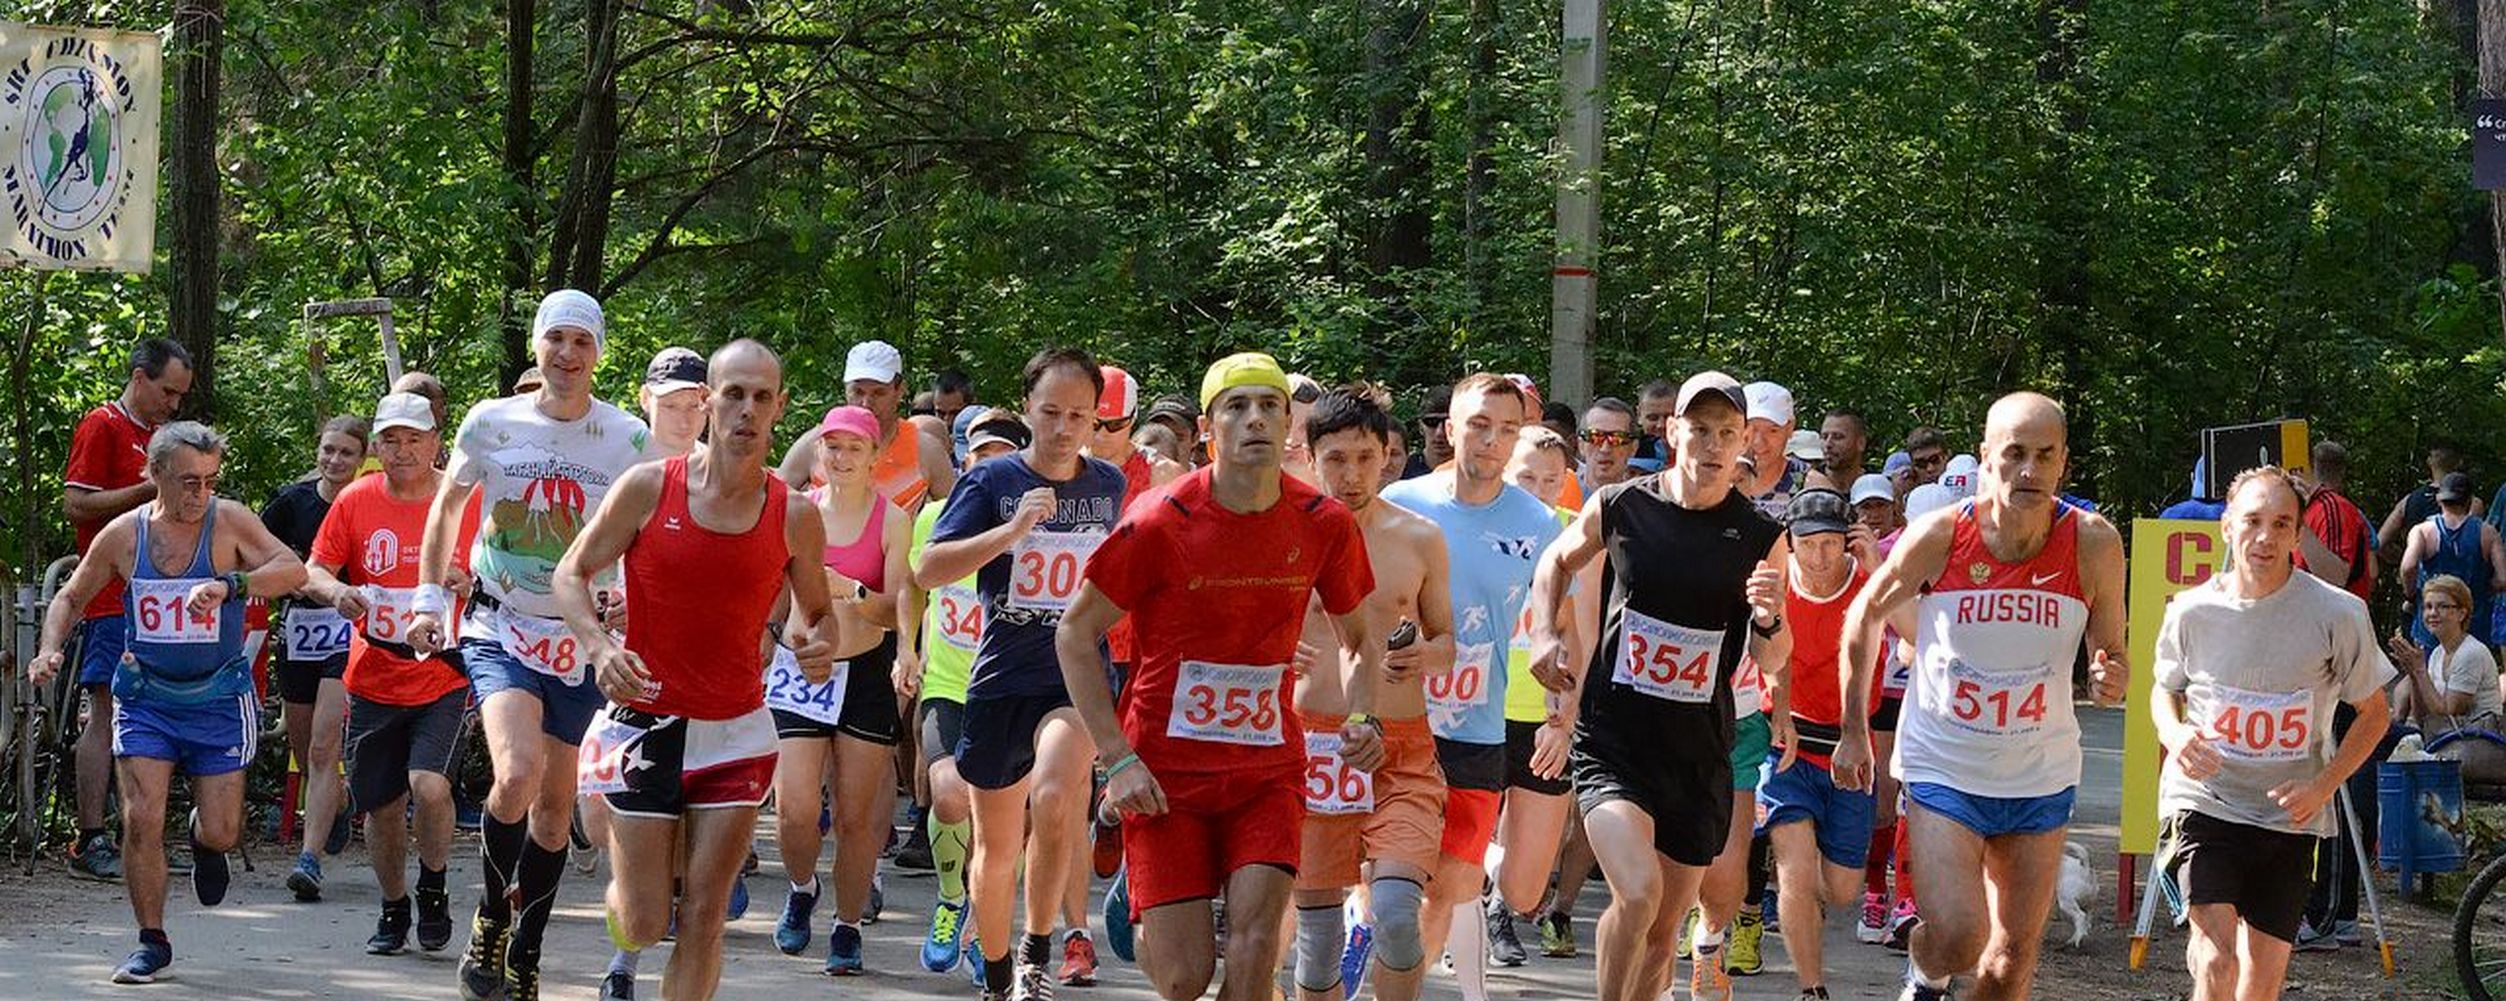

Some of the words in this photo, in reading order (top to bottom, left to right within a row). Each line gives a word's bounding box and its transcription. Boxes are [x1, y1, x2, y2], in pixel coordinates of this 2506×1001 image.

[1016, 551, 1084, 599] 30
[1957, 594, 2060, 629] RUSSIA
[294, 622, 351, 651] 224
[1627, 633, 1711, 690] 354
[769, 667, 835, 712] 234
[1185, 684, 1276, 731] 358
[1953, 680, 2047, 728] 514
[2214, 706, 2307, 750] 405
[1306, 756, 1366, 802] 56
